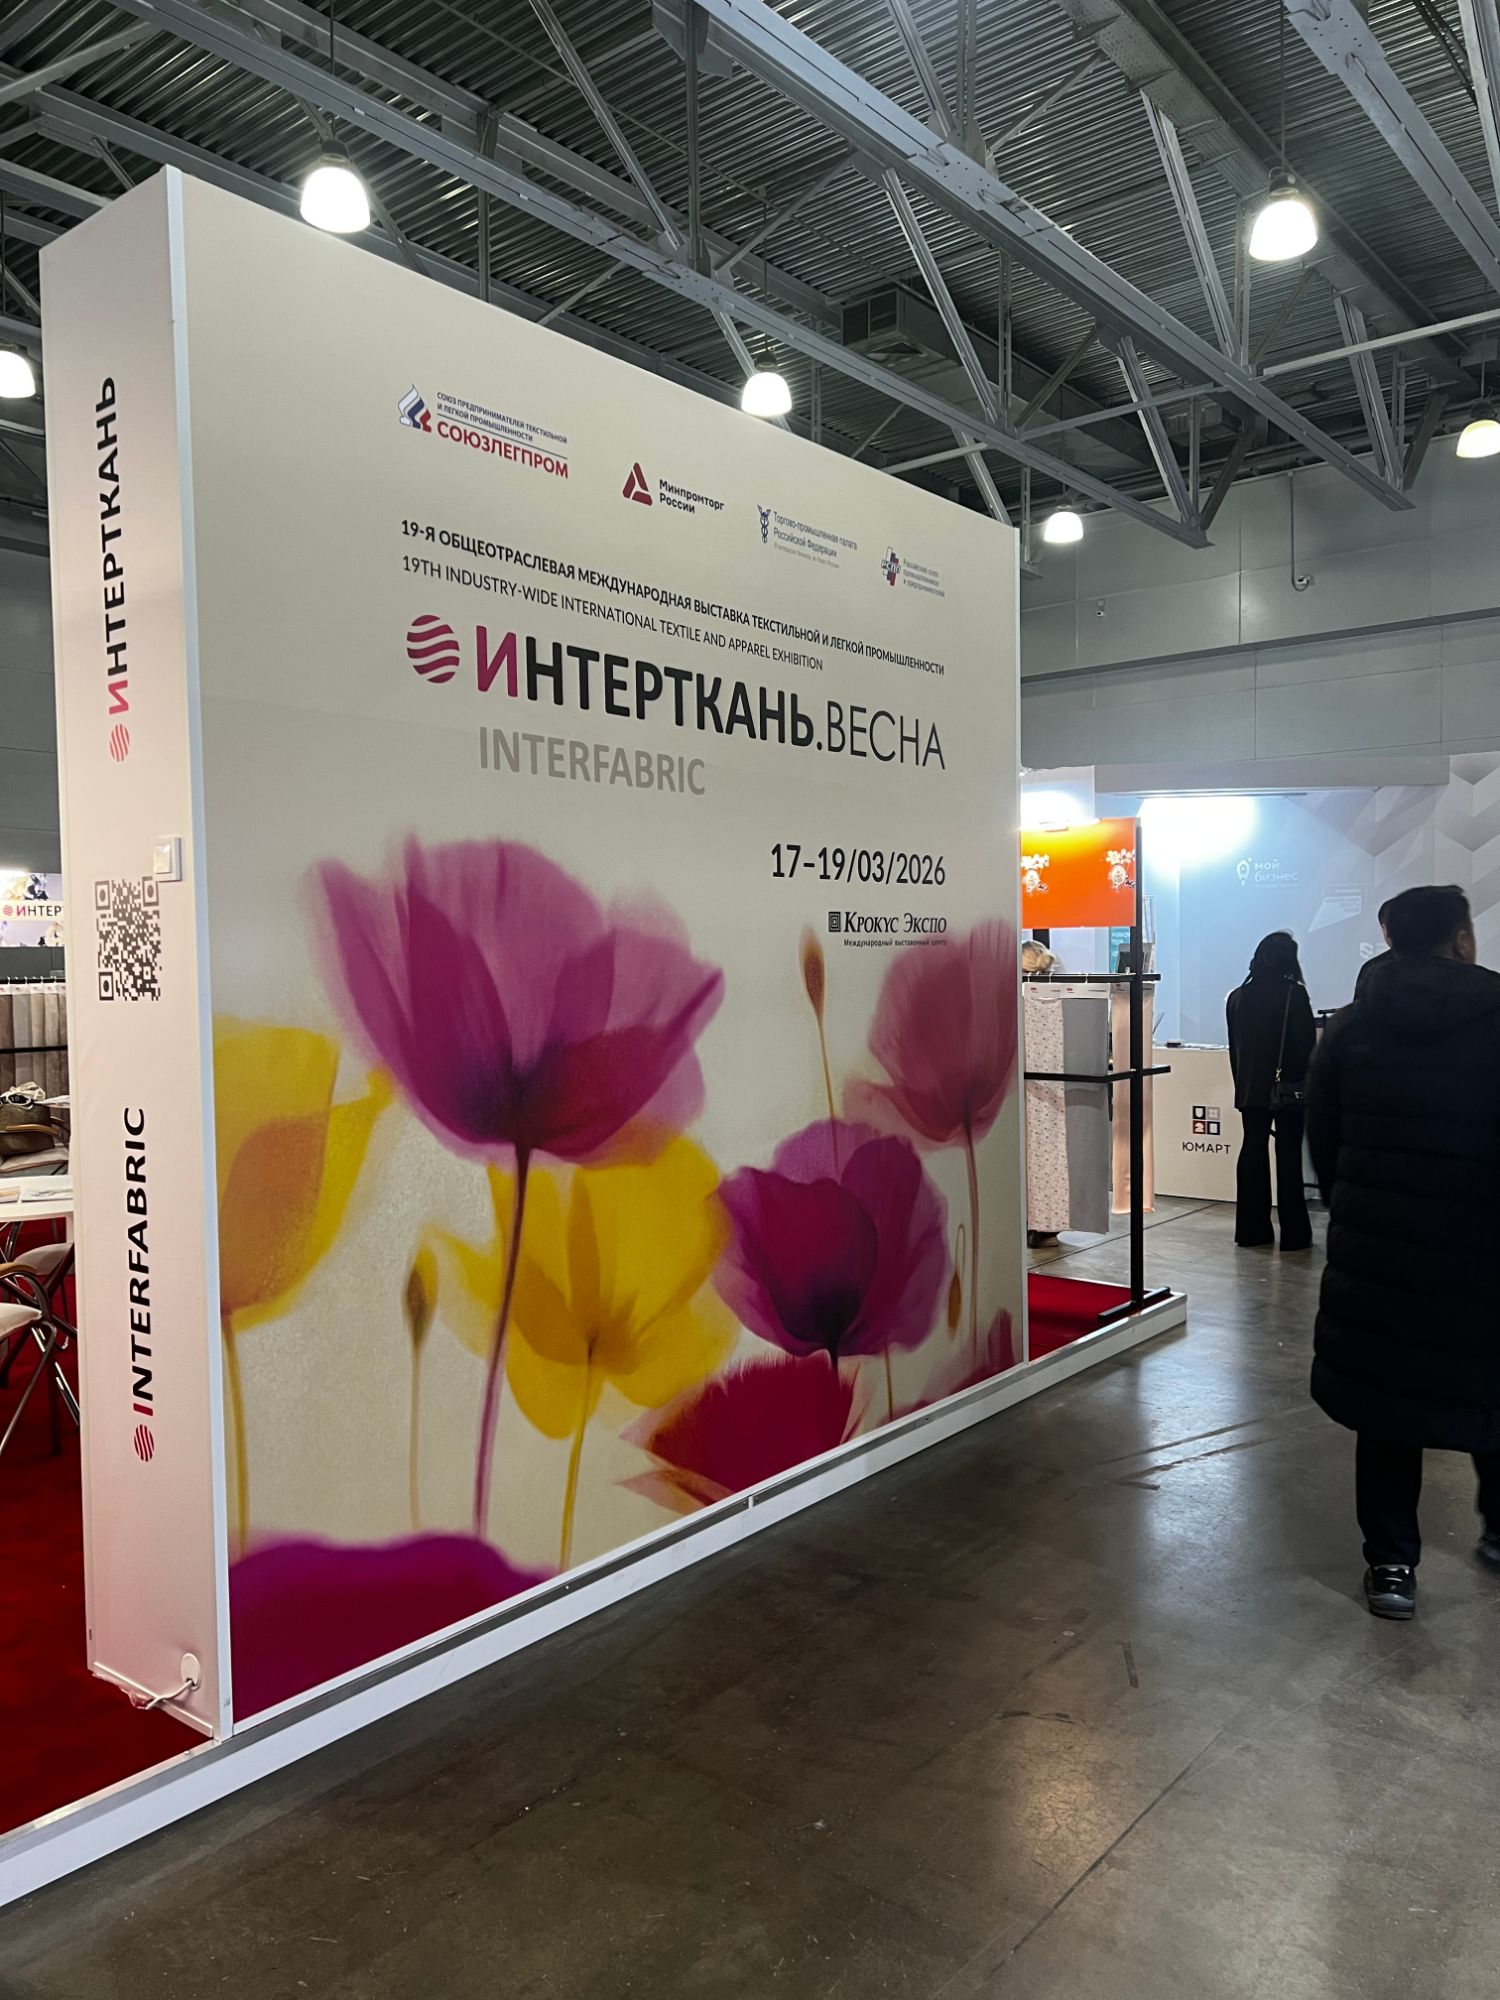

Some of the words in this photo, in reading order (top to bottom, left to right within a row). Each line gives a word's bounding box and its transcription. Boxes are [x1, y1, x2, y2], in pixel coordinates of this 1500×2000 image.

[437, 392, 456, 405] СОЮЗ
[457, 400, 524, 428] ПРЕДПРИНИМАТЕЛЕЙ
[525, 423, 567, 443] ТЕКСТИЛЬНОЙ
[437, 403, 443, 411] И
[444, 404, 469, 419] ЛЕГКОЙ
[470, 414, 533, 442] ПРОМЫШЛЕННОСТИ
[437, 421, 568, 479] СОЮЗЛЕГПРОМ
[659, 479, 724, 511] Минпромторг
[659, 492, 695, 514] России
[95, 376, 130, 715] ИНТЕРТКАНЬ
[401, 520, 435, 542] 19-Я
[439, 530, 575, 579] ОБЩЕОТРАСЛЕВАЯ
[578, 567, 692, 611] МЕЖДУНАРОДНАЯ
[694, 599, 751, 626] ВЫСТАВКА
[751, 614, 820, 645] ТЕКСТИЛЬНОЙ
[822, 633, 829, 647] И
[830, 635, 864, 656] ЛЕГКОЙ
[865, 645, 945, 676] ПРОМЫШЛЕННОСТИ
[402, 555, 442, 579] 19TH
[446, 565, 558, 608] INDUSTRY-WIDE
[561, 595, 657, 632] INTERNATIONAL
[659, 619, 701, 642] TEXTILE
[703, 631, 726, 648] AND
[728, 637, 771, 659] APPAREL
[772, 647, 824, 672] EXHIBITION
[475, 625, 946, 770] ИНТЕРТКАНЬ.ВЕСНА
[479, 727, 705, 796] INTERFABRIC
[771, 843, 946, 886] 17-19/03/2026
[16, 905, 64, 917] ИНТЕР
[843, 938, 893, 948] Международный
[1182, 1142, 1231, 1154] ЮМАРТ
[124, 1107, 154, 1417] INTERFABRIC
